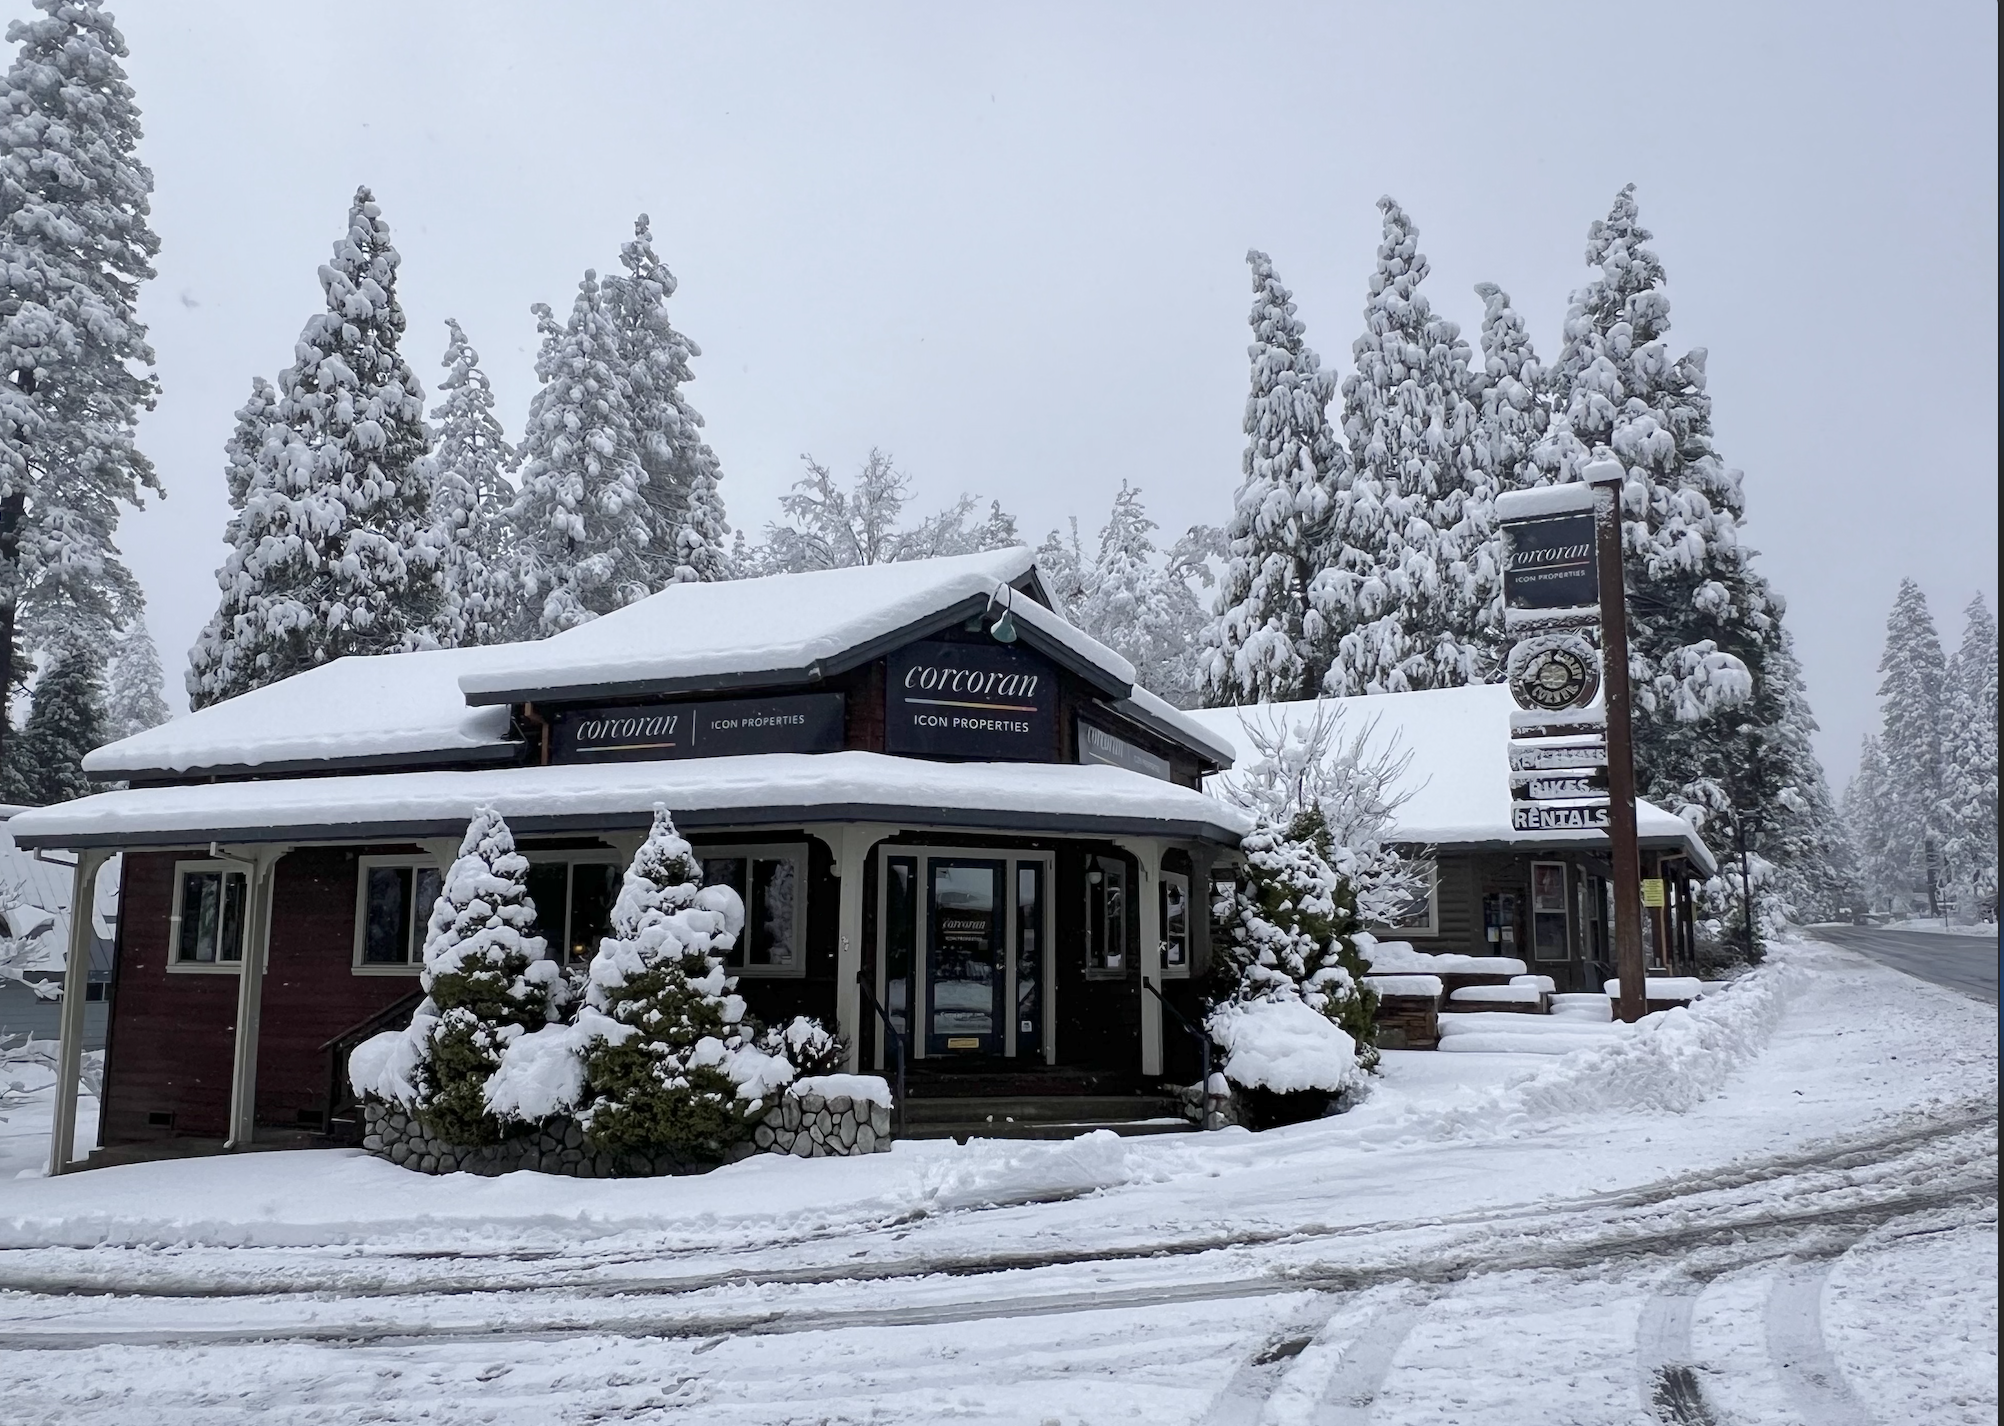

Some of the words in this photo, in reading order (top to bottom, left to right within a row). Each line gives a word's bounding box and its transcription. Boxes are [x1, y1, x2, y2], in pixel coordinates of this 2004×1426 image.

[1509, 543, 1590, 564] corcoran
[1515, 574, 1536, 583] ICON
[1538, 569, 1586, 581] PROPERTIES
[904, 665, 1038, 698] corcoran
[576, 715, 679, 740] corcoran
[711, 719, 738, 730] ICON
[741, 714, 805, 728] PROPERTIES
[914, 714, 948, 727] ICON
[952, 717, 1029, 733] PROPERTIES
[1529, 779, 1590, 798] BIKES
[1514, 808, 1608, 828] RENTALS
